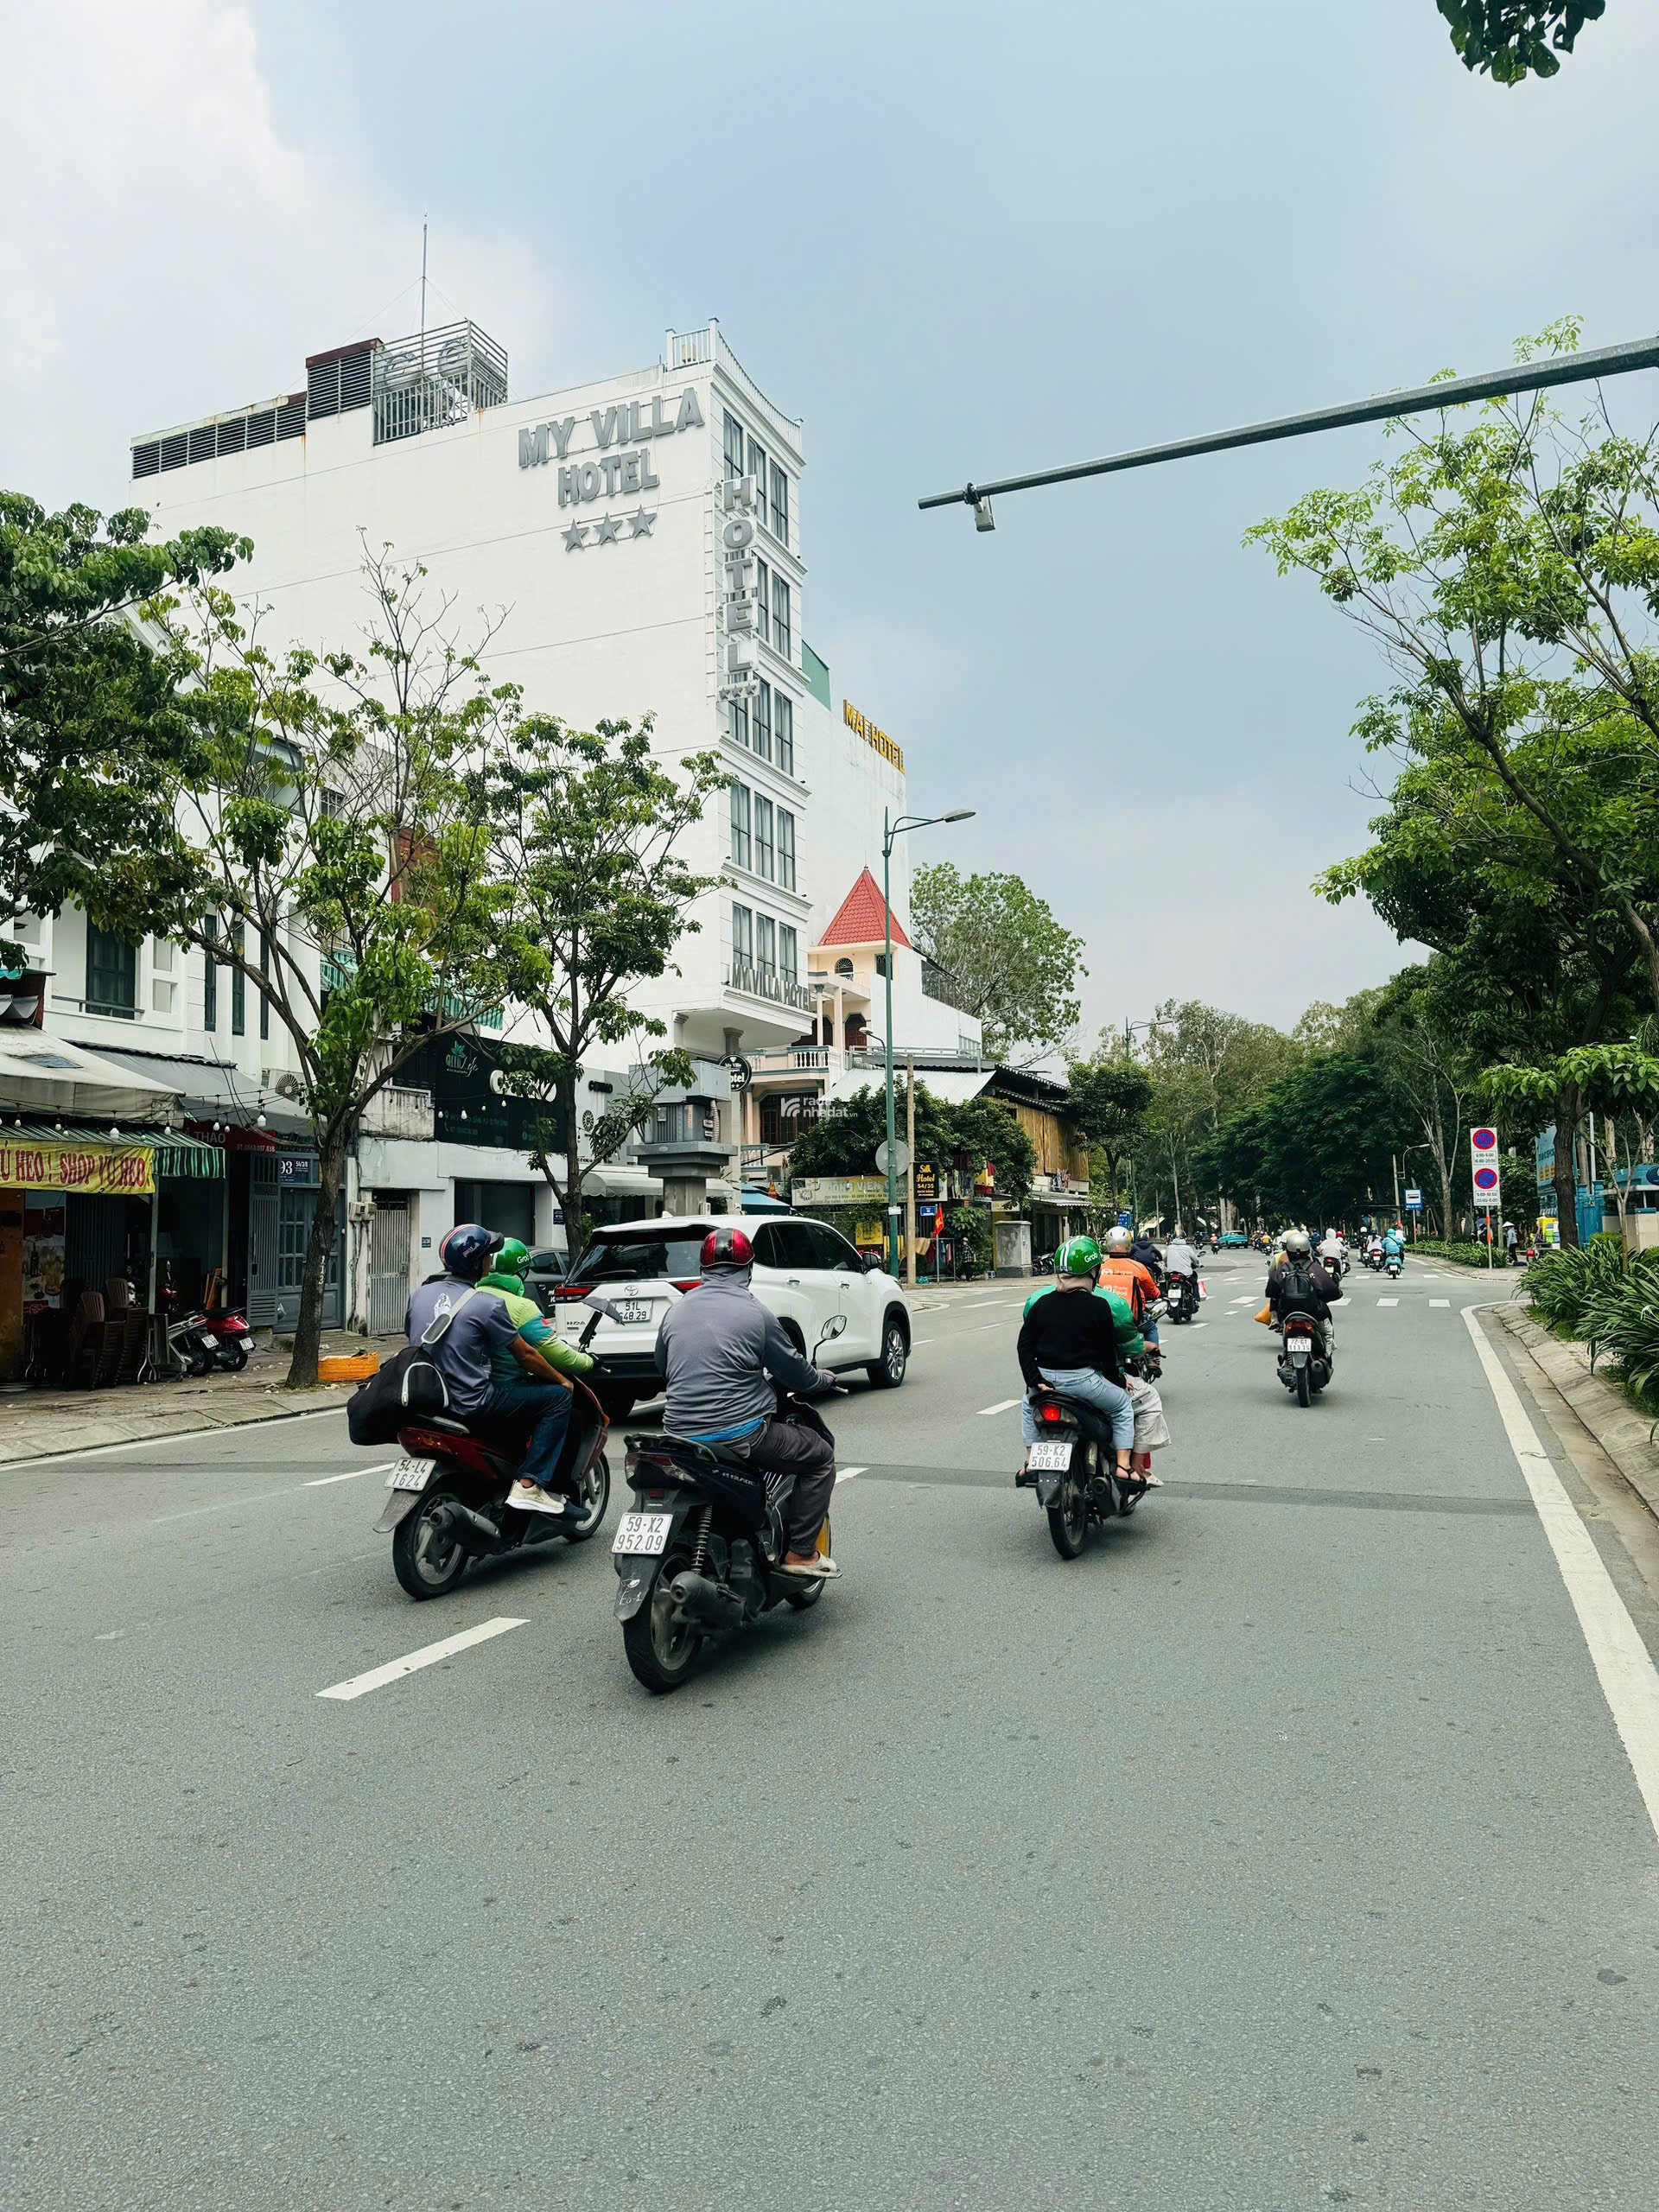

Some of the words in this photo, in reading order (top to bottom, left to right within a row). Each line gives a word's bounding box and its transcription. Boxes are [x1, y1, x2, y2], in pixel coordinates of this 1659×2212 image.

[518, 416, 575, 468] MY
[589, 387, 705, 448] VILLA
[557, 448, 659, 506] HOTEL
[724, 477, 754, 671] HOTEL
[870, 722, 906, 775] HOTEL
[731, 1072, 745, 1083] otel
[16, 1149, 43, 1182] HEO
[60, 1153, 95, 1185] SHOP
[119, 1156, 145, 1188] HEO
[919, 1164, 931, 1173] Silk
[916, 1173, 935, 1182] Hotel
[1084, 1251, 1098, 1263] Grab
[626, 1301, 640, 1311] 51L
[1032, 1456, 1066, 1468] 506.64
[392, 1472, 422, 1488] 1624
[626, 1516, 664, 1534] 59-X2
[616, 1535, 663, 1551] 952.09
